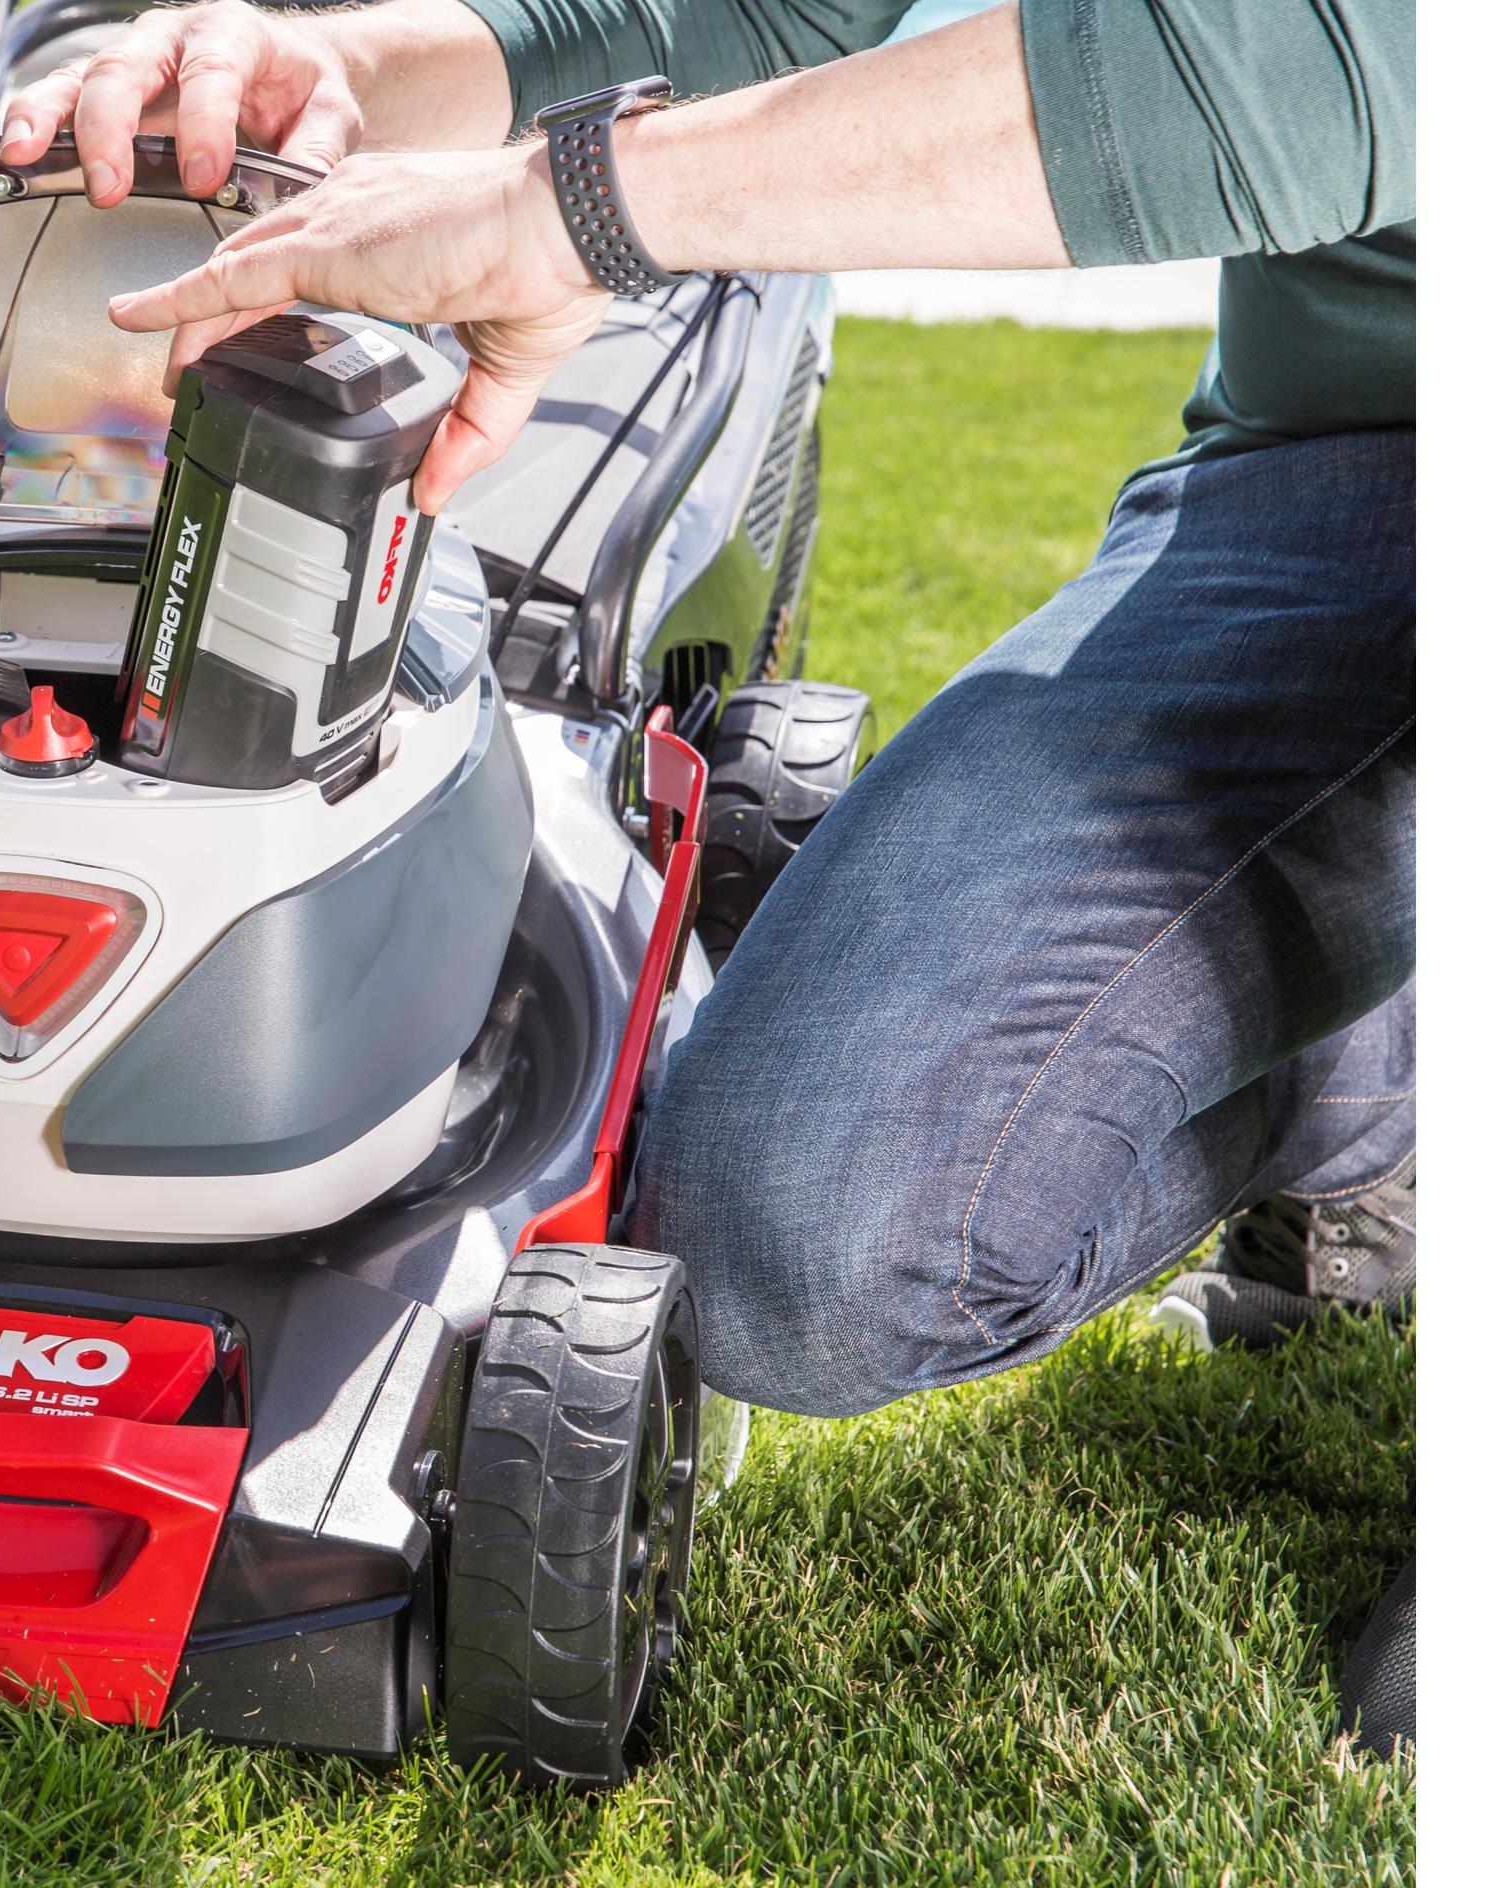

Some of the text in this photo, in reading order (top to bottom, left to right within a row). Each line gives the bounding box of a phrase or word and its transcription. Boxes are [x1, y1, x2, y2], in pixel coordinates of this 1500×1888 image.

[378, 515, 407, 605] AL-KO
[145, 515, 202, 697] ENERGY FLEX
[319, 728, 335, 742] 40
[336, 722, 345, 734] V
[35, 1391, 59, 1404] Li
[61, 1394, 100, 1407] SP
